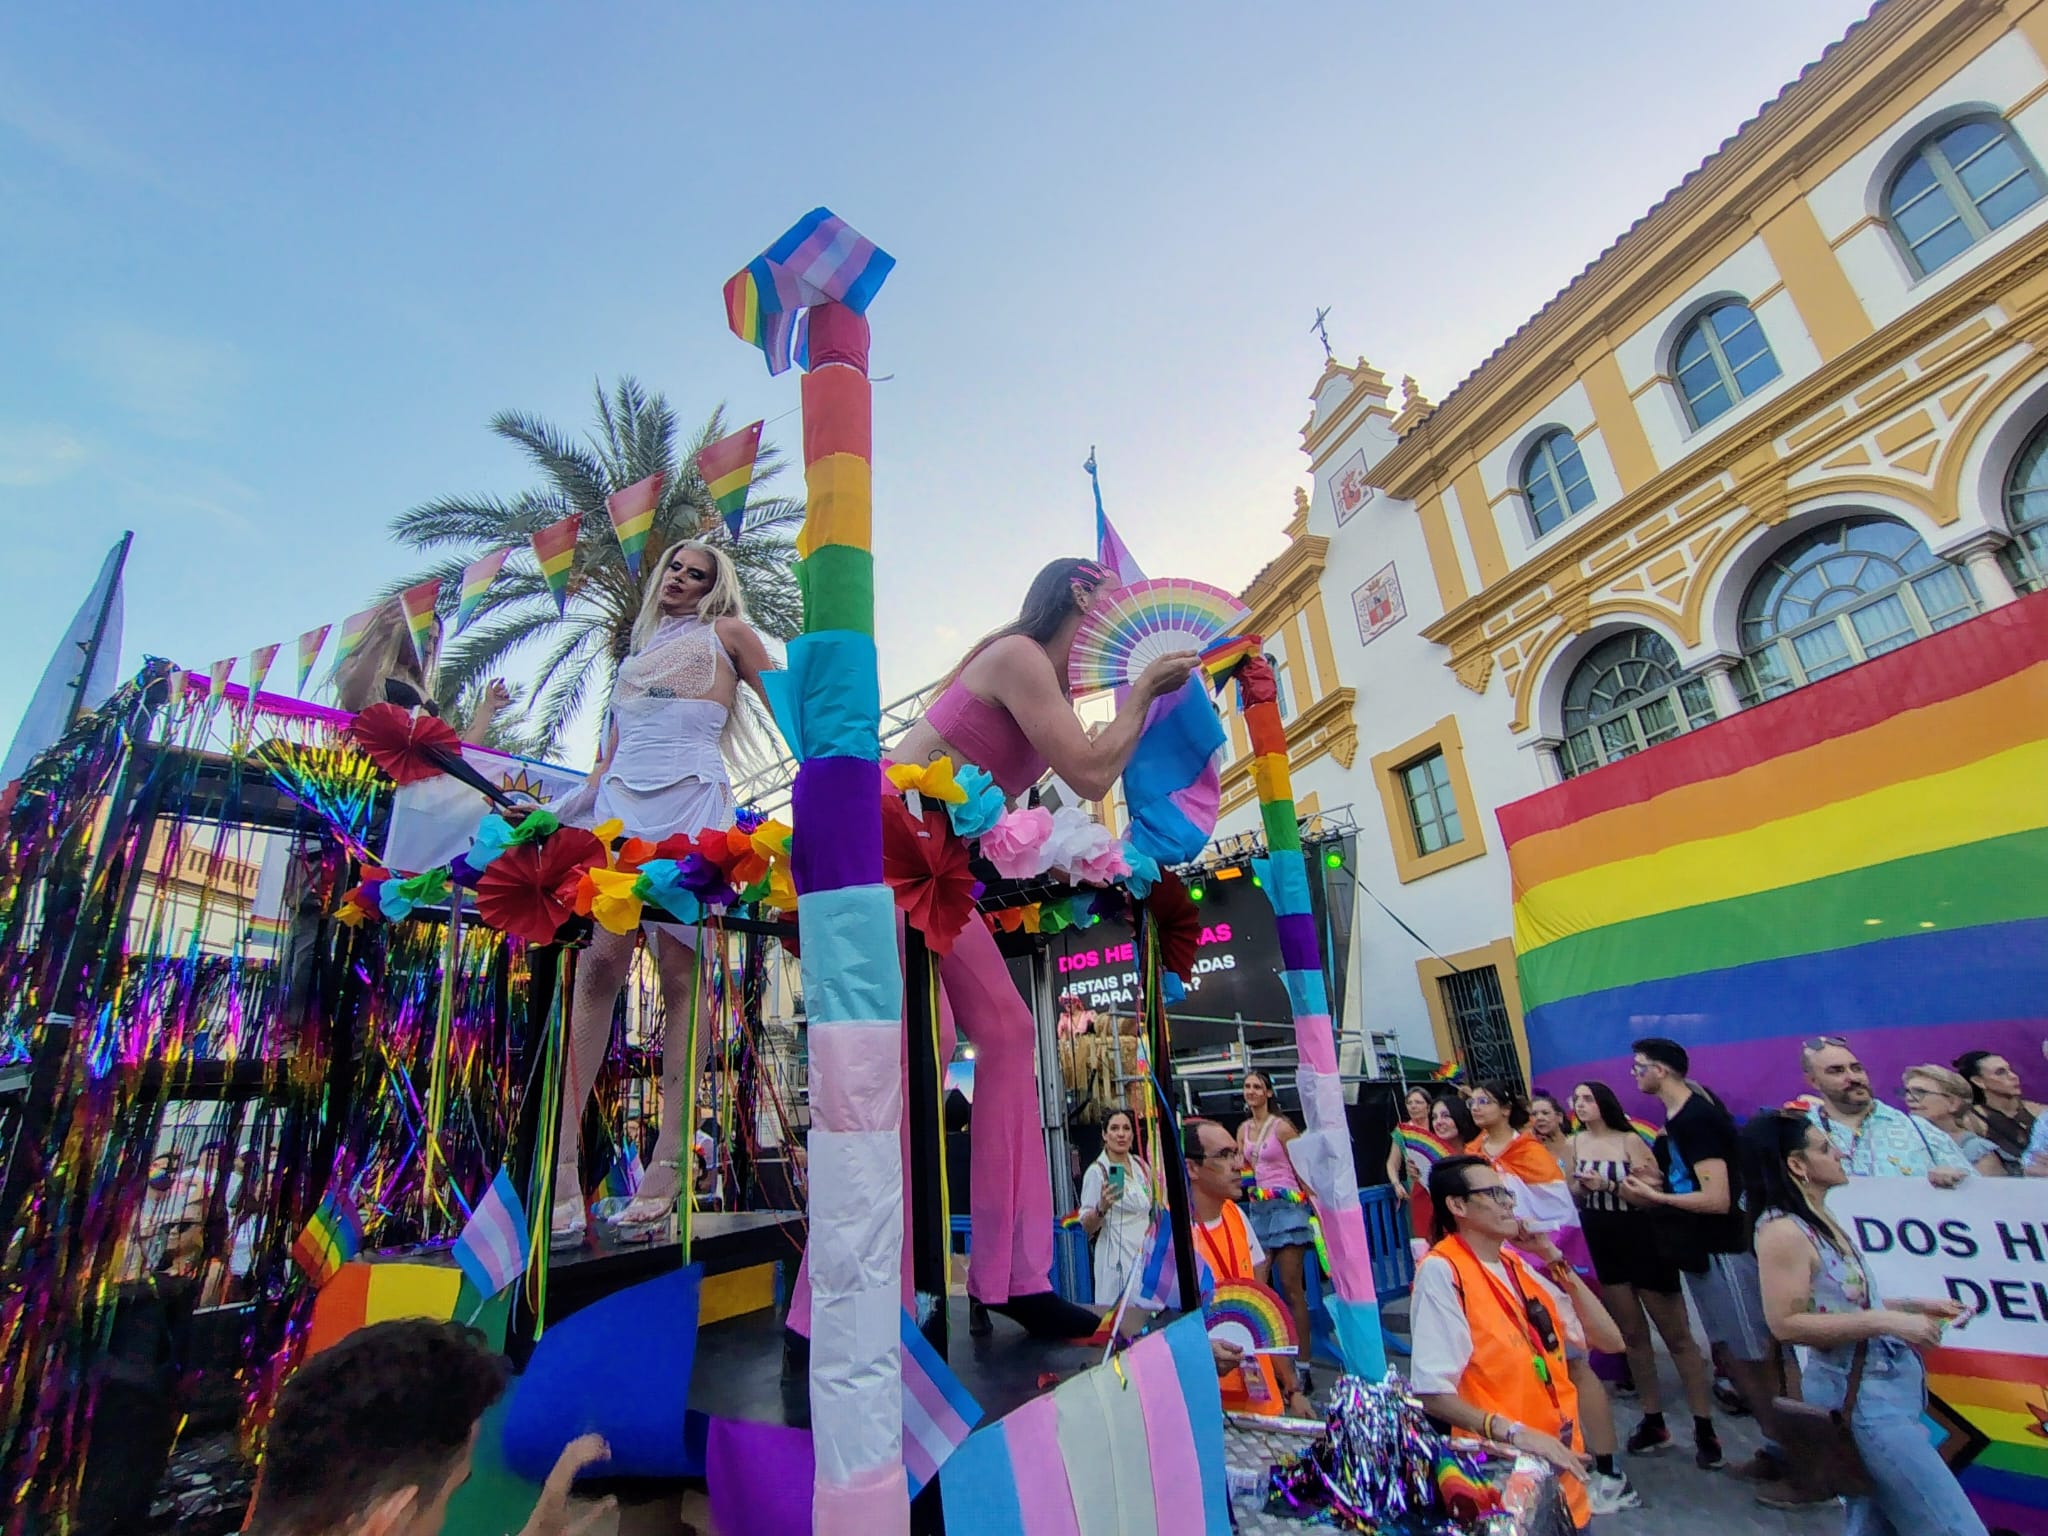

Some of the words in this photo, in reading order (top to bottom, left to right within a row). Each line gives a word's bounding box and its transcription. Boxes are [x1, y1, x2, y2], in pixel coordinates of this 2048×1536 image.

[1058, 949, 1100, 973] DOS
[1090, 988, 1134, 1007] PARA
[1853, 1215, 1978, 1260] DOS
[1994, 1219, 2048, 1263] H
